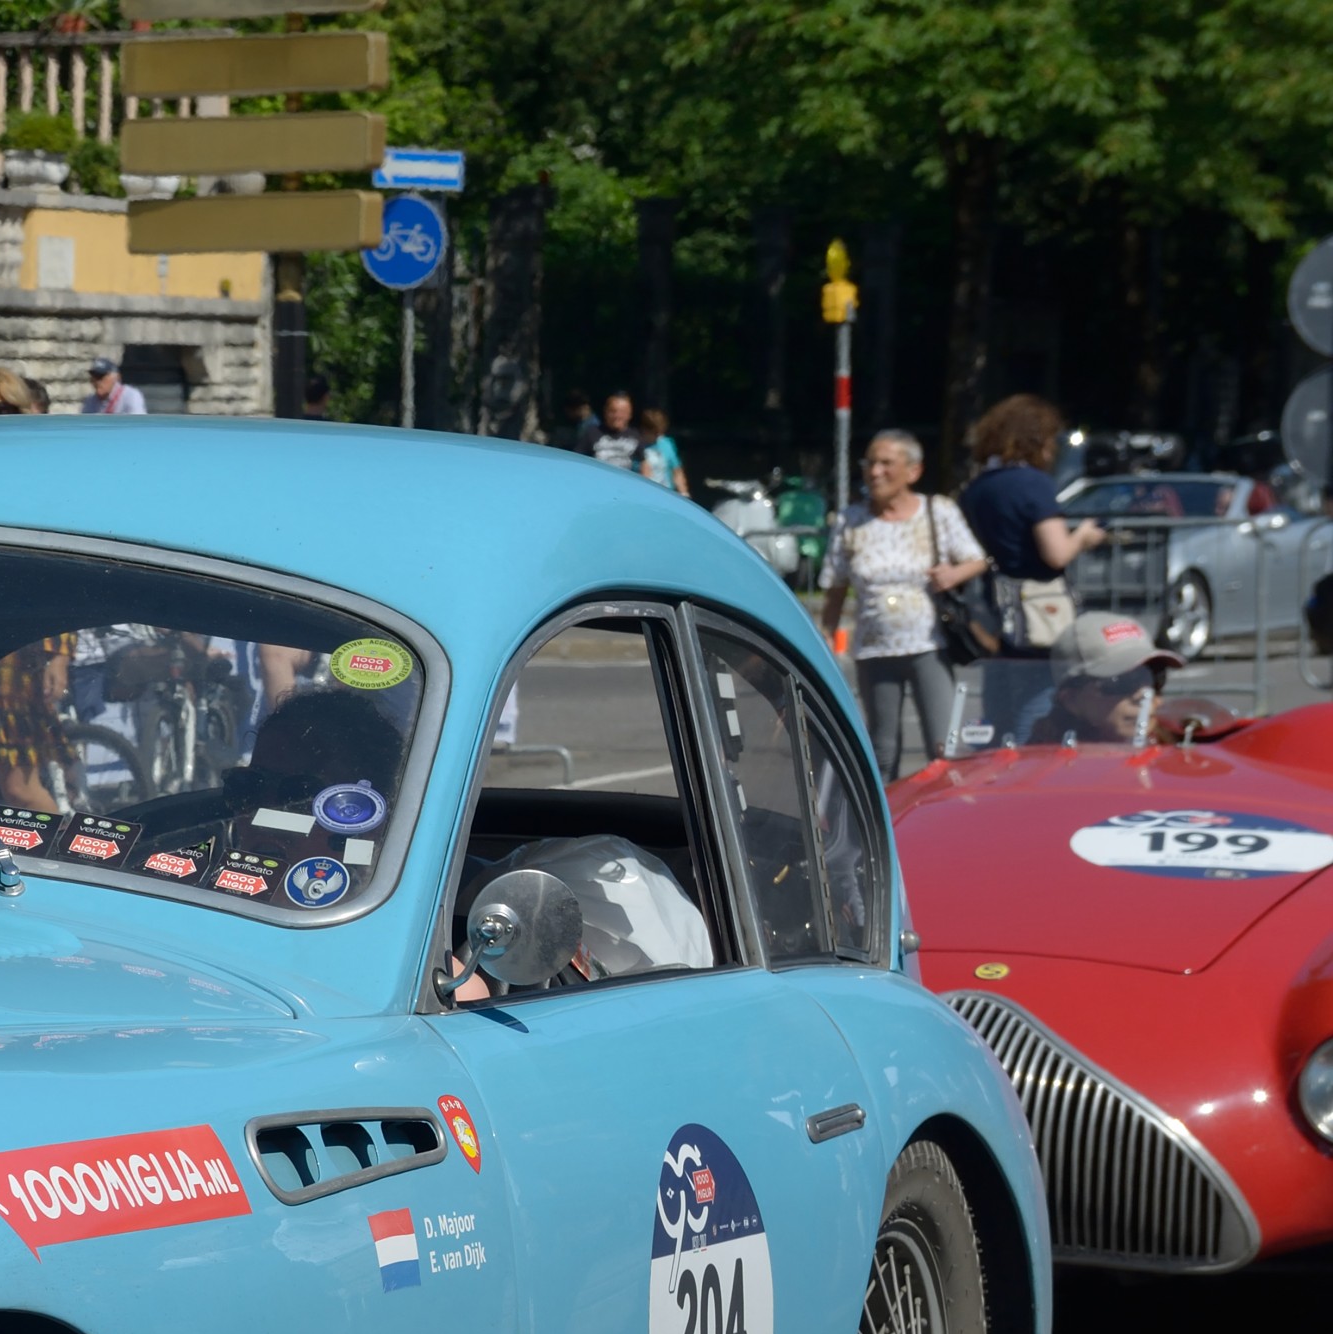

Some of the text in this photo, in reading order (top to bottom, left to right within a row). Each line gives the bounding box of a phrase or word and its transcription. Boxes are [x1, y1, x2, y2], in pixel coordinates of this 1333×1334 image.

[351, 662, 384, 671] MIGLIA
[355, 656, 384, 665] 1000
[0, 816, 47, 830] verificato
[0, 828, 31, 839] 1000
[79, 825, 126, 840] verificato
[79, 837, 109, 849] 1000
[1141, 831, 1270, 855] 199
[72, 844, 107, 856] MIGLIA
[156, 854, 186, 866] 1000
[148, 860, 184, 874] MIGLIA
[226, 861, 274, 876] verificato
[226, 873, 256, 884] 1000
[220, 880, 254, 892] MIGLIA
[696, 1173, 710, 1185] 1000
[8, 1149, 239, 1222] 1000MIGLIA.NL
[696, 1188, 712, 1200] MIGLIA
[423, 1211, 475, 1239] D. Majoor
[429, 1242, 486, 1273] E. van Dijk
